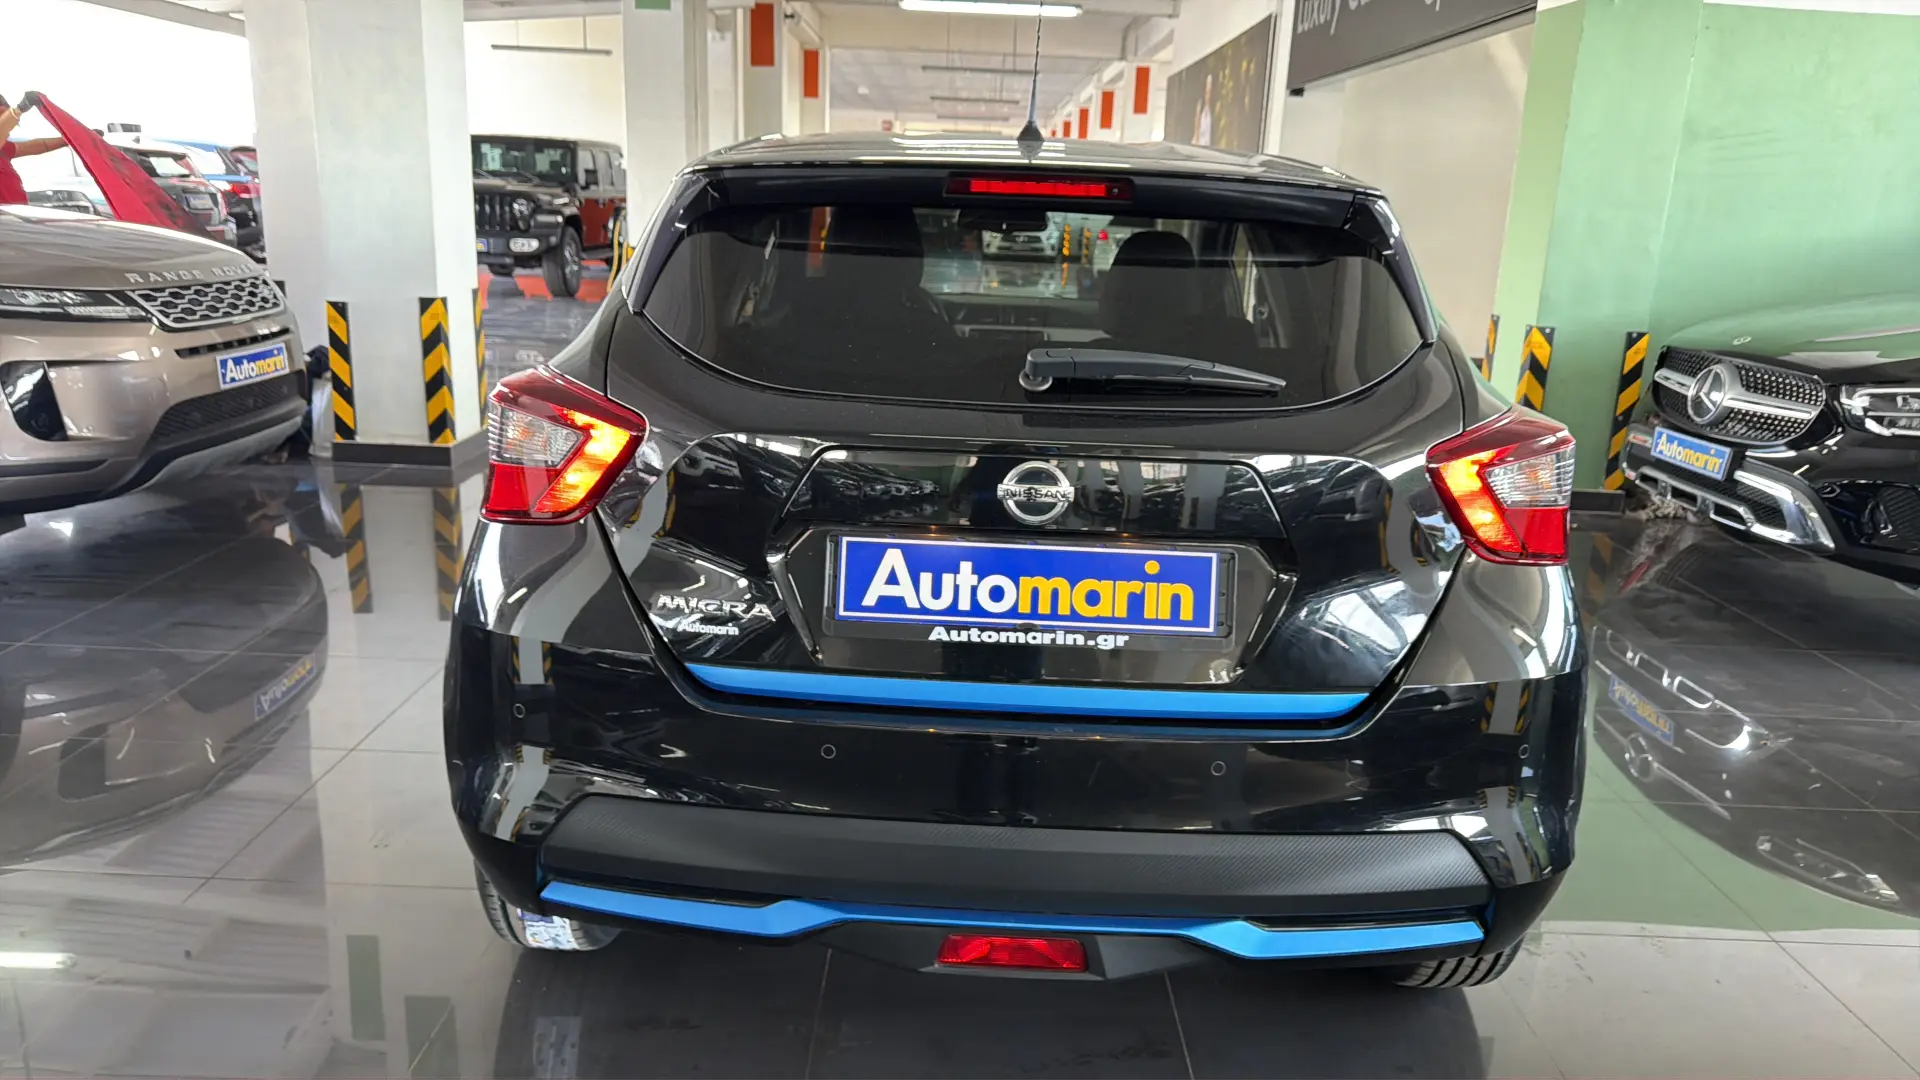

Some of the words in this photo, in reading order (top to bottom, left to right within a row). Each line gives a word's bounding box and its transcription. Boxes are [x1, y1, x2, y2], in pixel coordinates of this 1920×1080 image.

[124, 269, 205, 284] RANGE
[225, 348, 285, 383] Automarin
[1656, 432, 1721, 473] Automarin
[1006, 487, 1068, 501] NISSAN
[861, 547, 1194, 621] Automarin
[656, 594, 776, 622] MICRA
[677, 621, 740, 636] Automarin
[928, 625, 1129, 651] Automarin.gr
